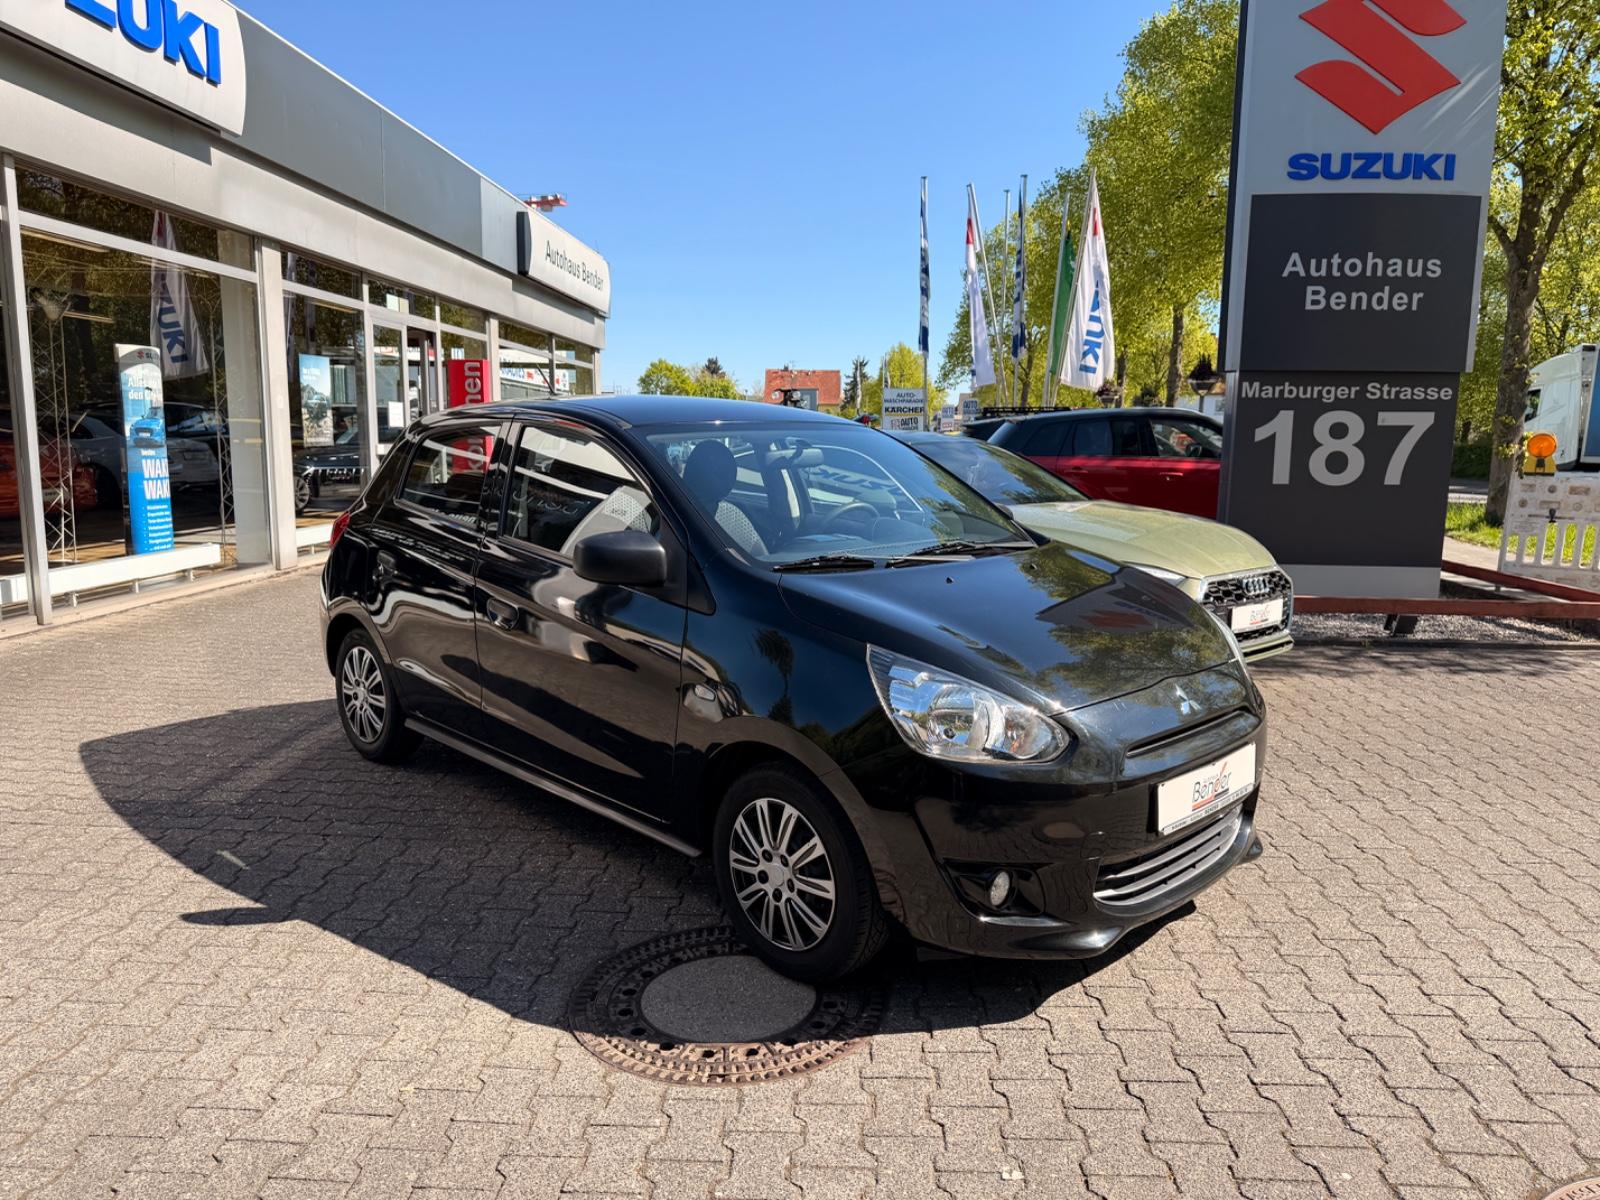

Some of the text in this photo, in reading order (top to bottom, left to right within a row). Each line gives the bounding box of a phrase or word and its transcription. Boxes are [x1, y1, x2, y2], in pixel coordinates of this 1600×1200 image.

[1287, 152, 1456, 181] SUZUKI
[545, 240, 604, 291] Autohaus Bender
[1282, 252, 1442, 278] Autohaus
[1305, 286, 1424, 311] Bender
[1079, 280, 1105, 374] UKI
[1241, 381, 1453, 403] Marburger Strasse
[1254, 409, 1435, 487] 187
[143, 479, 171, 499] WAK
[1193, 771, 1231, 802] Bender
